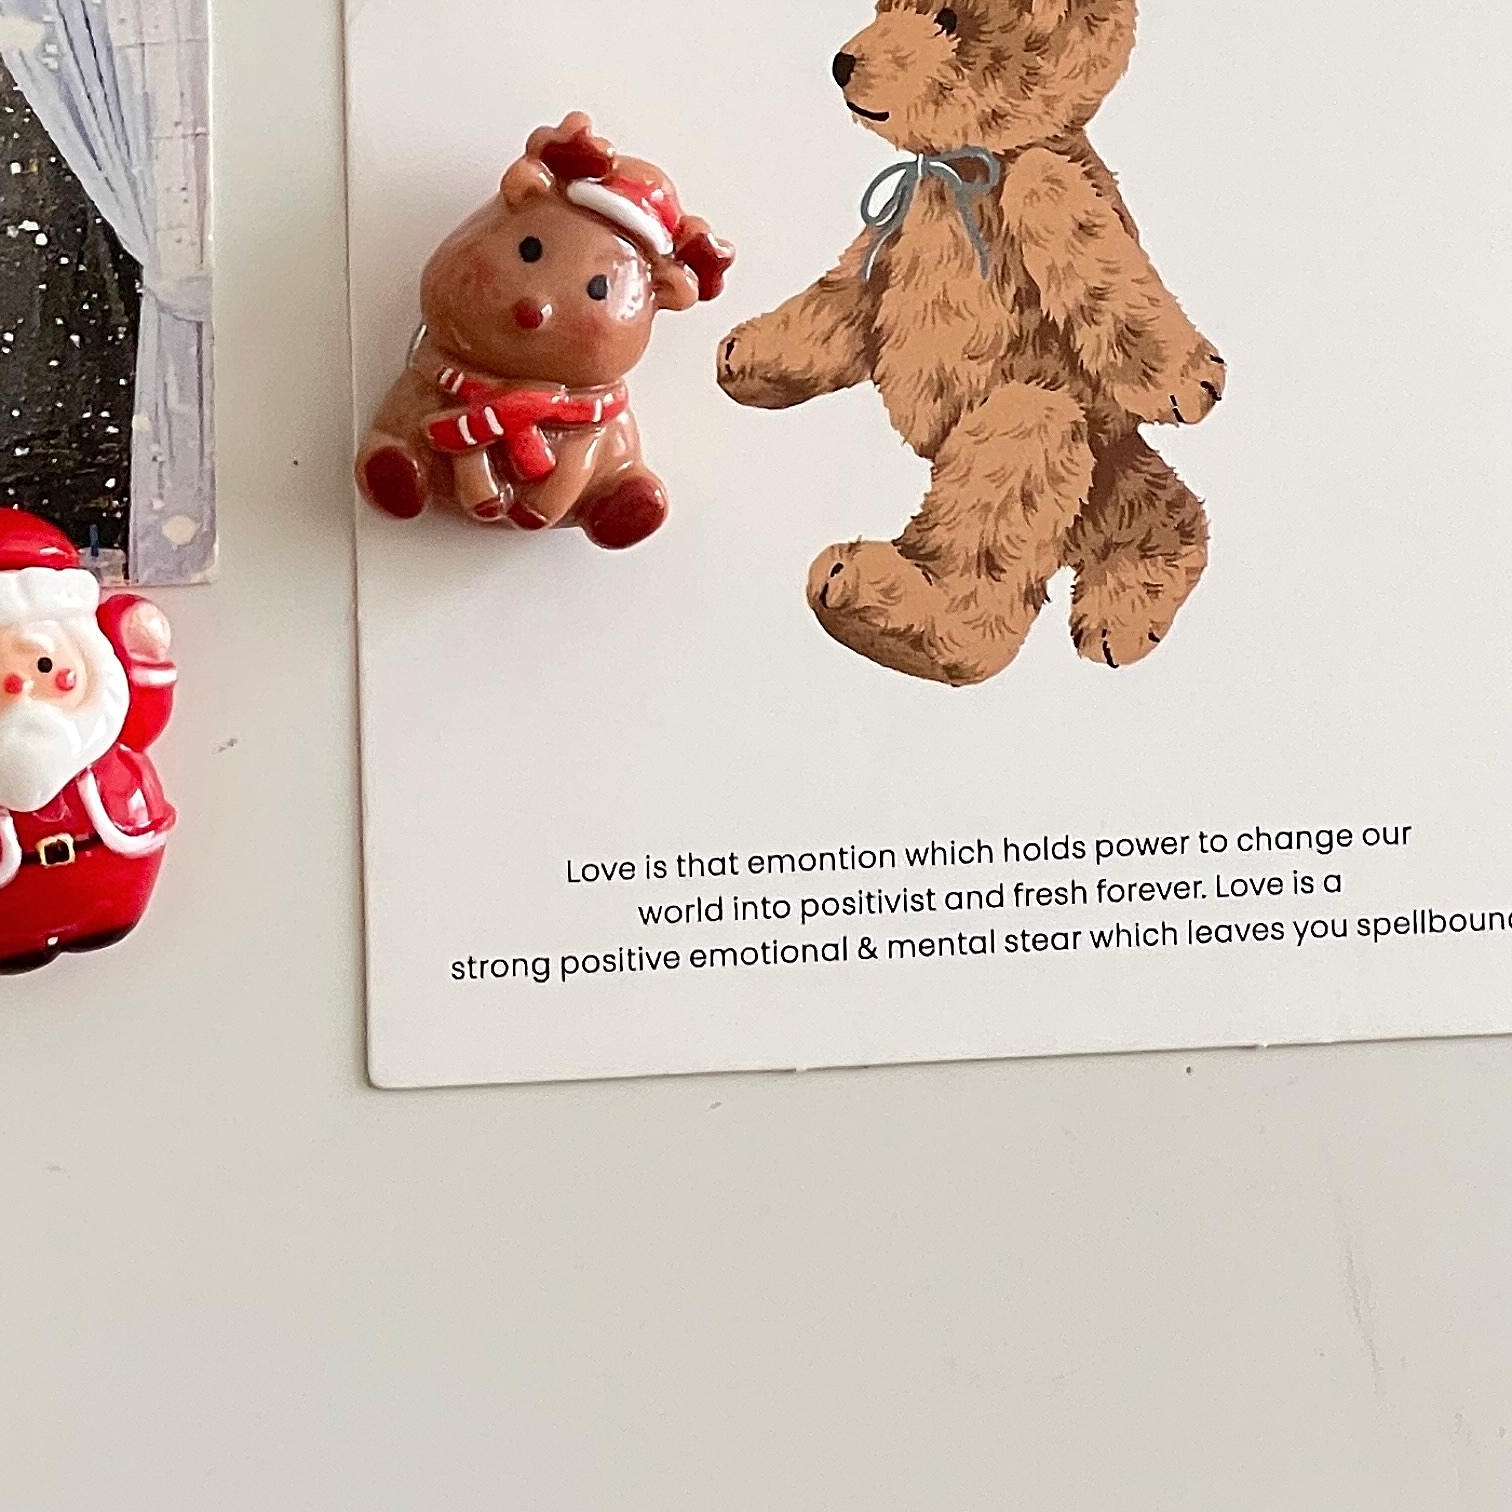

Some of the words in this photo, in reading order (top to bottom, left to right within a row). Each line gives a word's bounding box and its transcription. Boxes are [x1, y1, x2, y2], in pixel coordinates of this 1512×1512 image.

[567, 859, 636, 883] Love
[645, 854, 668, 880] is
[676, 852, 739, 878] that
[747, 844, 896, 875] emontion
[905, 838, 994, 867] which
[1003, 834, 1086, 863] holds
[1095, 835, 1190, 866] power
[1198, 831, 1228, 854] to
[1237, 826, 1353, 855] change
[1362, 825, 1412, 847] our
[637, 895, 723, 926] world
[733, 895, 791, 921] into
[801, 887, 937, 925] positivist
[944, 882, 1004, 911] and
[1013, 879, 1087, 908] fresh
[1096, 878, 1207, 904] forever.
[1216, 874, 1284, 898] Love
[1293, 869, 1314, 895] is
[1323, 874, 1341, 894] a
[451, 955, 550, 984] strong
[561, 946, 681, 983] positive
[689, 935, 848, 968] emotional
[857, 936, 879, 960] &
[888, 928, 995, 959] mental
[1004, 929, 1082, 953] stear
[1089, 920, 1178, 949] which
[1188, 919, 1285, 945] leaves
[1292, 918, 1348, 947] you
[1357, 908, 1512, 944] spellboun
